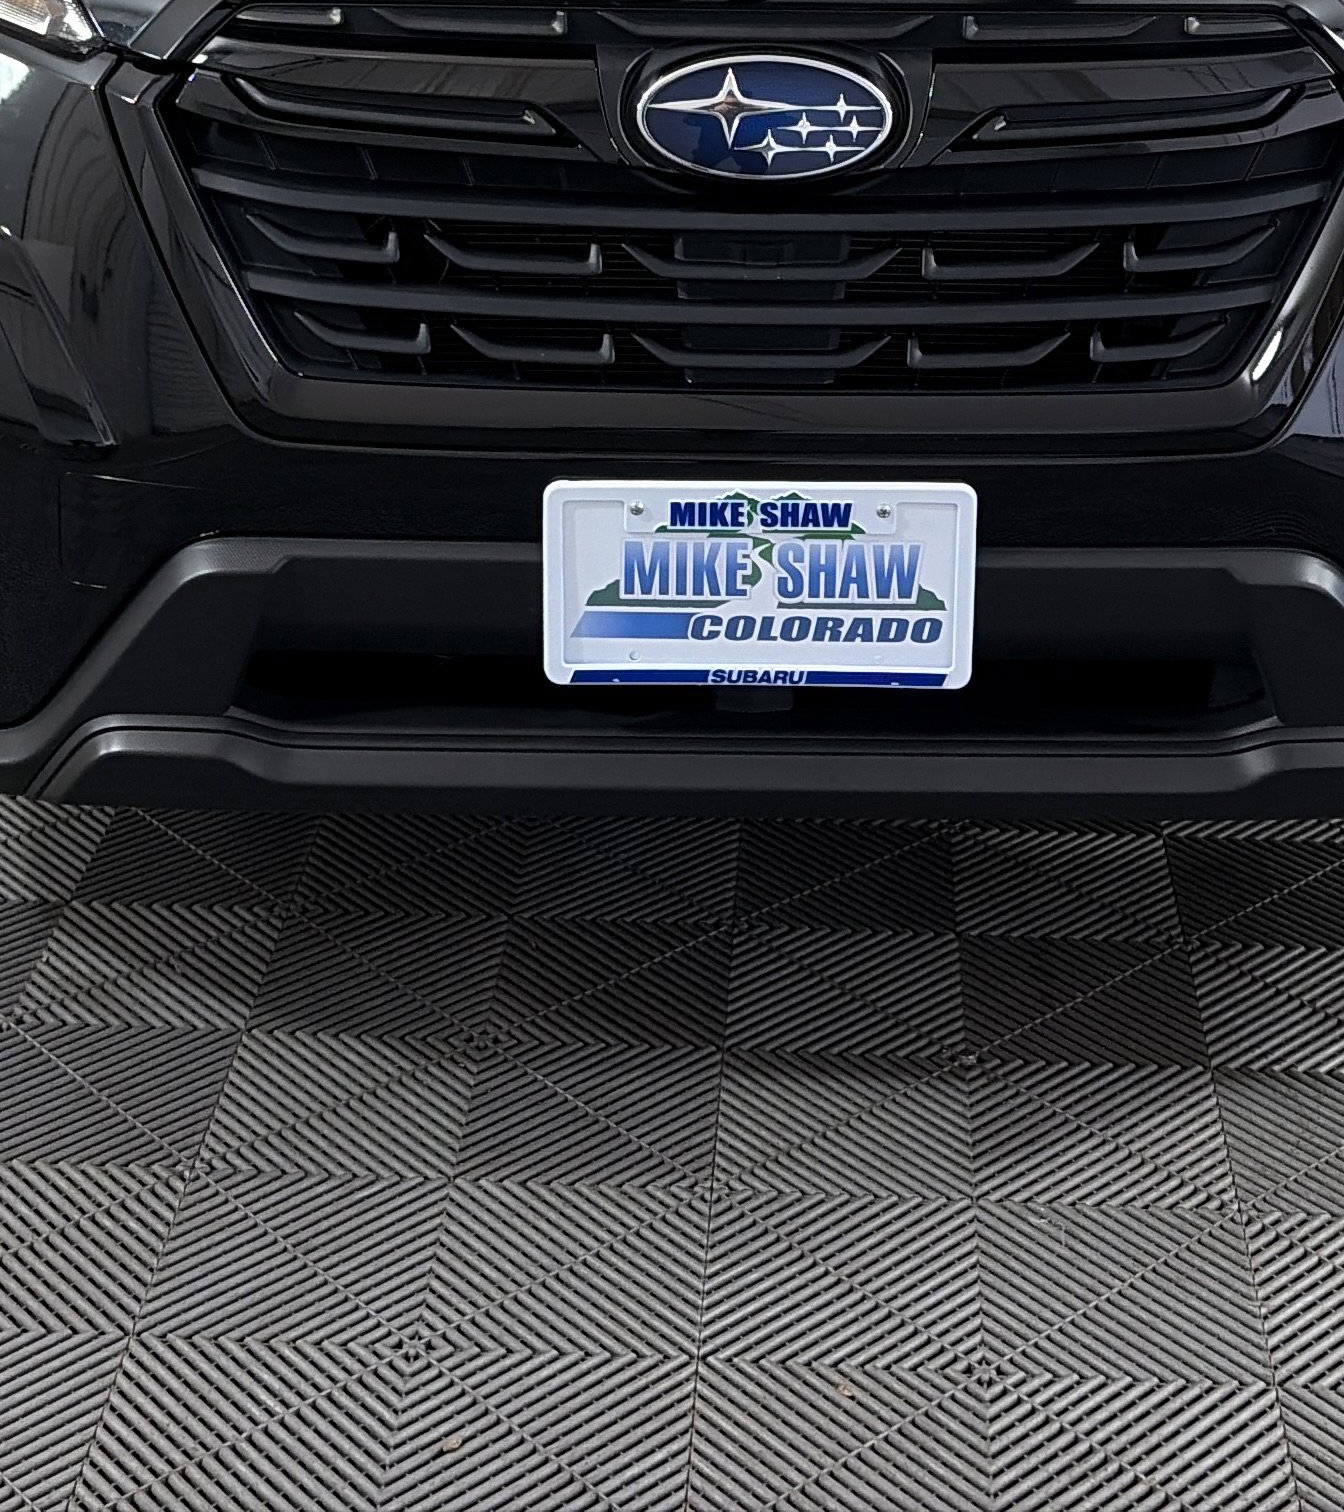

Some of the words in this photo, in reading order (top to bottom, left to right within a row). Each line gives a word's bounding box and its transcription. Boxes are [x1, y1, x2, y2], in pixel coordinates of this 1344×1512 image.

[670, 501, 746, 528] MIKE
[759, 502, 853, 528] SHAW
[623, 540, 749, 597] MIKE
[776, 543, 921, 600] SHAW
[691, 614, 943, 644] COLORADO
[711, 669, 805, 685] SUBARU
